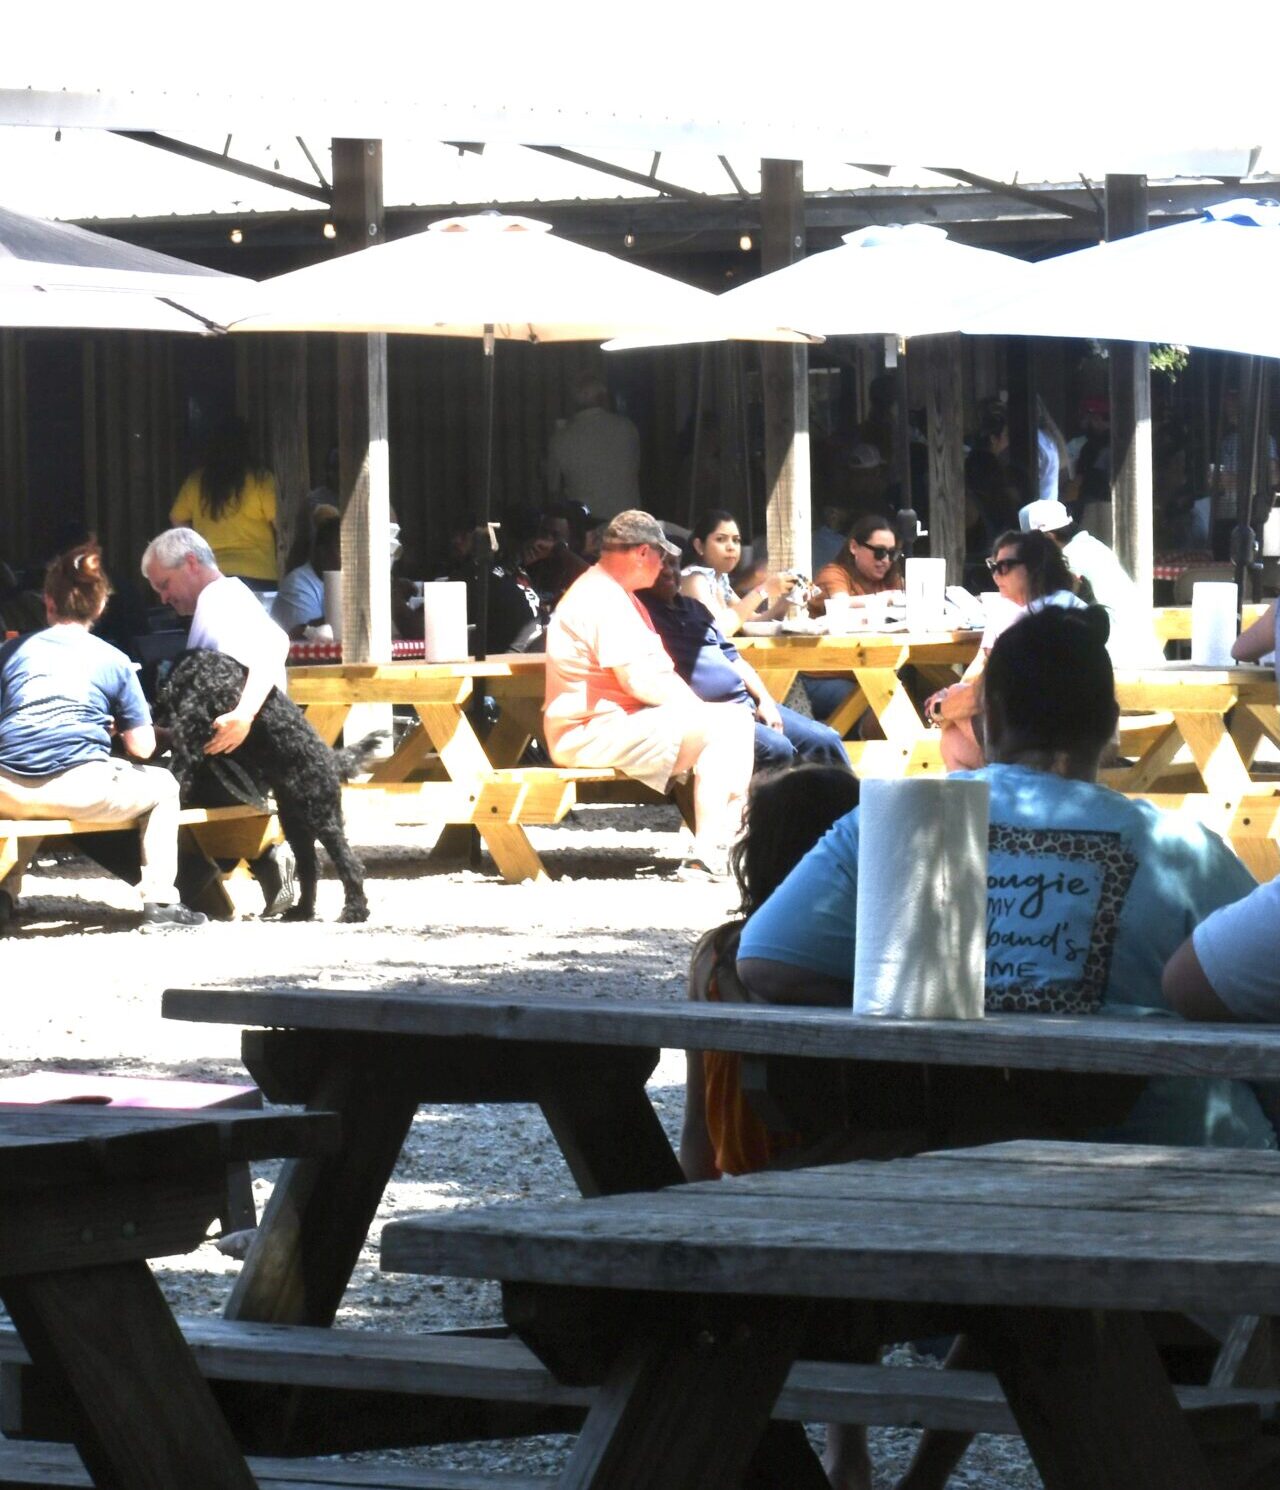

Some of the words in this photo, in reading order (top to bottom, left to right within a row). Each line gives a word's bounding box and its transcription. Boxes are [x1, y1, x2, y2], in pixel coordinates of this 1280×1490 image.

[986, 897, 1016, 916] MY
[987, 872, 1090, 919] ougie
[985, 917, 1089, 961] band's
[985, 961, 1039, 979] ME
